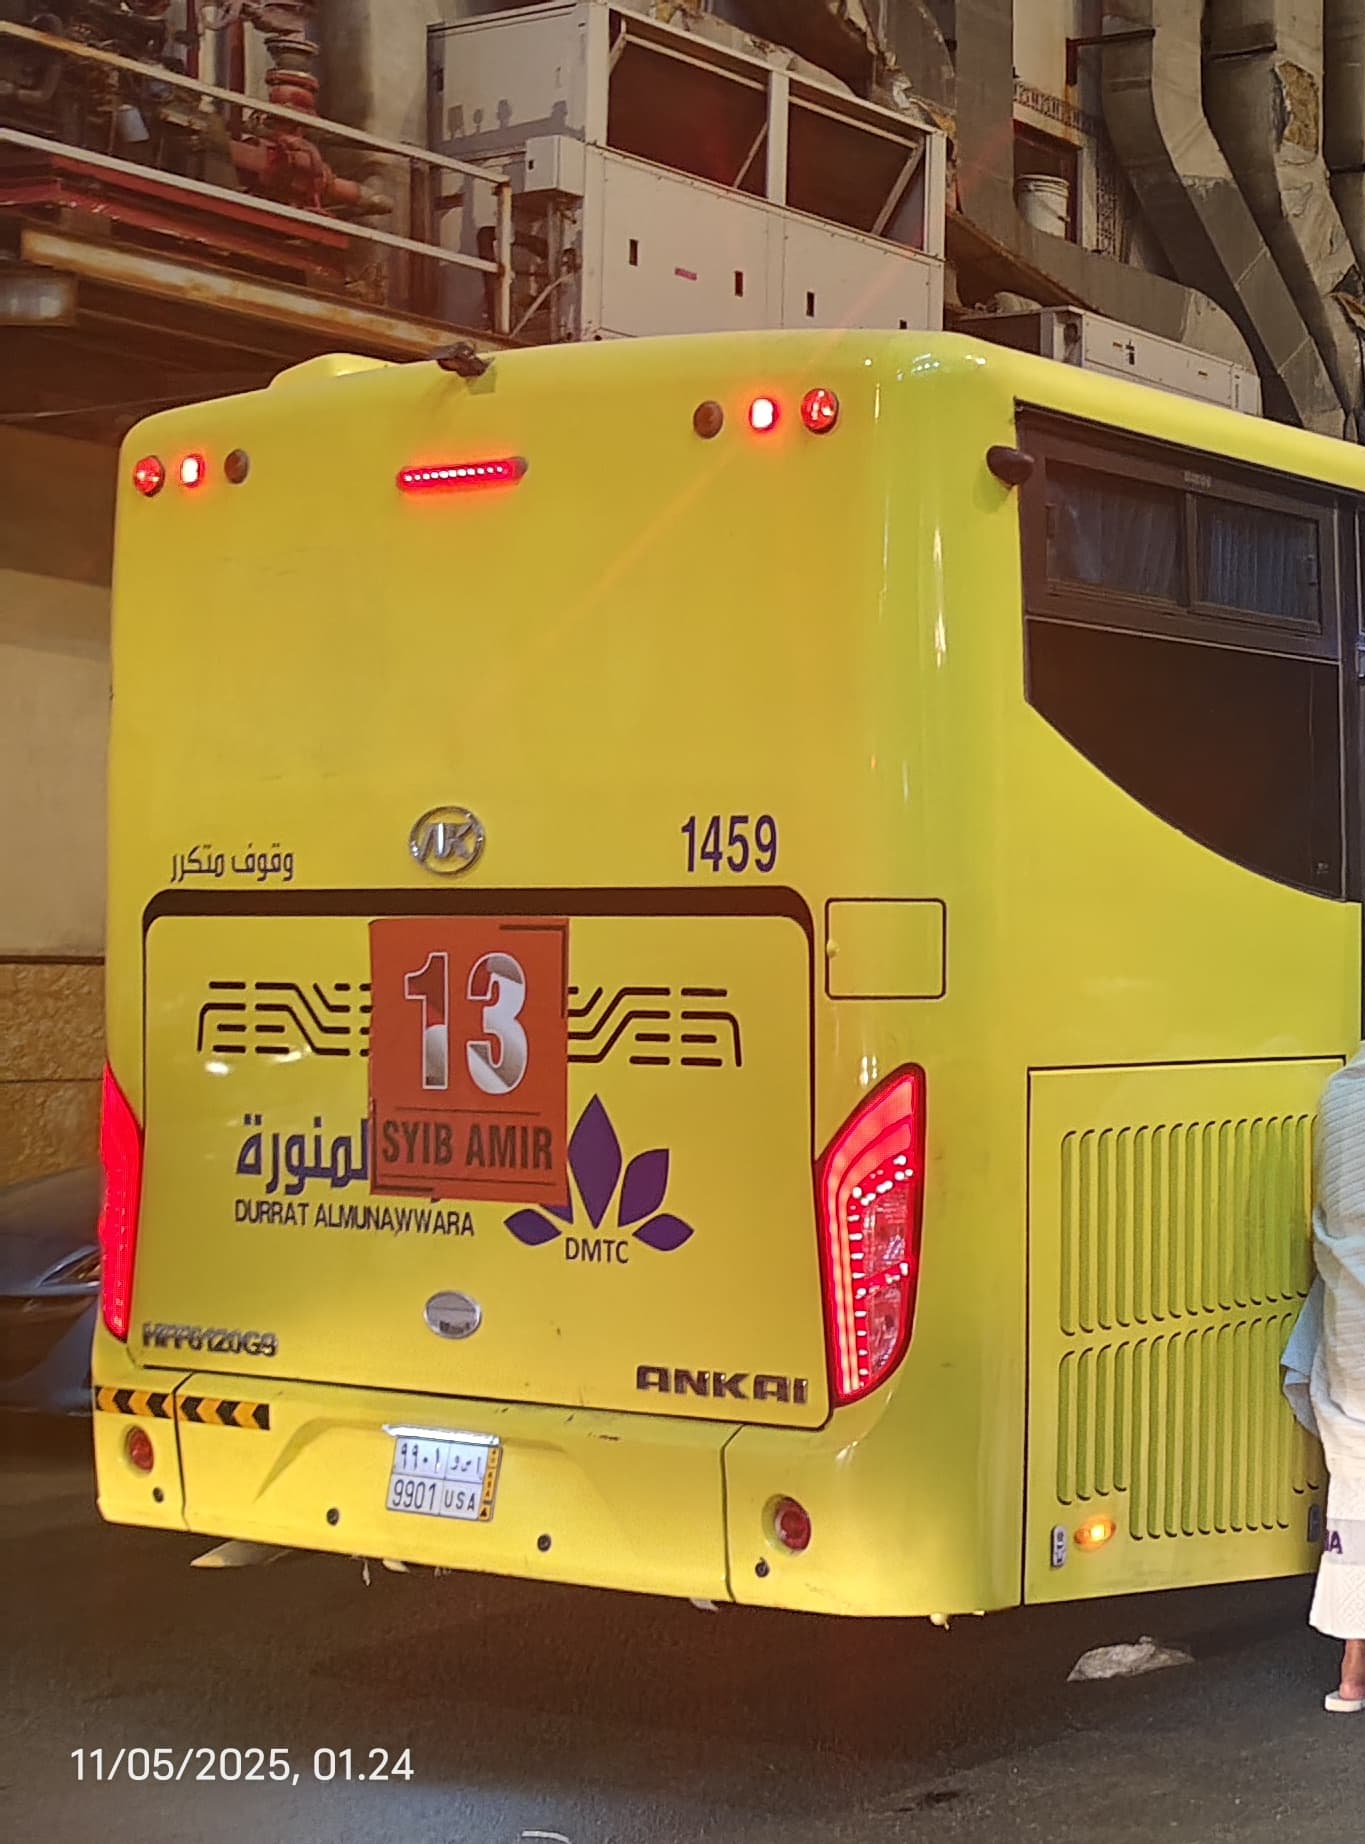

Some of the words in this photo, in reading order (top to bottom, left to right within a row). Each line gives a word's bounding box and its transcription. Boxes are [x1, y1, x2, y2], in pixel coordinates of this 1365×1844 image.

[169, 843, 226, 883] متكرر
[231, 842, 294, 882] وقوف
[680, 814, 778, 874] 1459
[403, 951, 529, 1095] 13
[237, 1113, 369, 1195] لمنورة
[381, 1120, 454, 1166] SYIB
[465, 1123, 553, 1170] AMIR
[235, 1199, 309, 1227] DURRAT
[314, 1203, 475, 1237] ALMUNAWWARA
[565, 1236, 630, 1265] DMTC
[636, 1364, 808, 1404] ANKAI
[392, 1479, 437, 1511] 9901
[444, 1489, 476, 1512] USA
